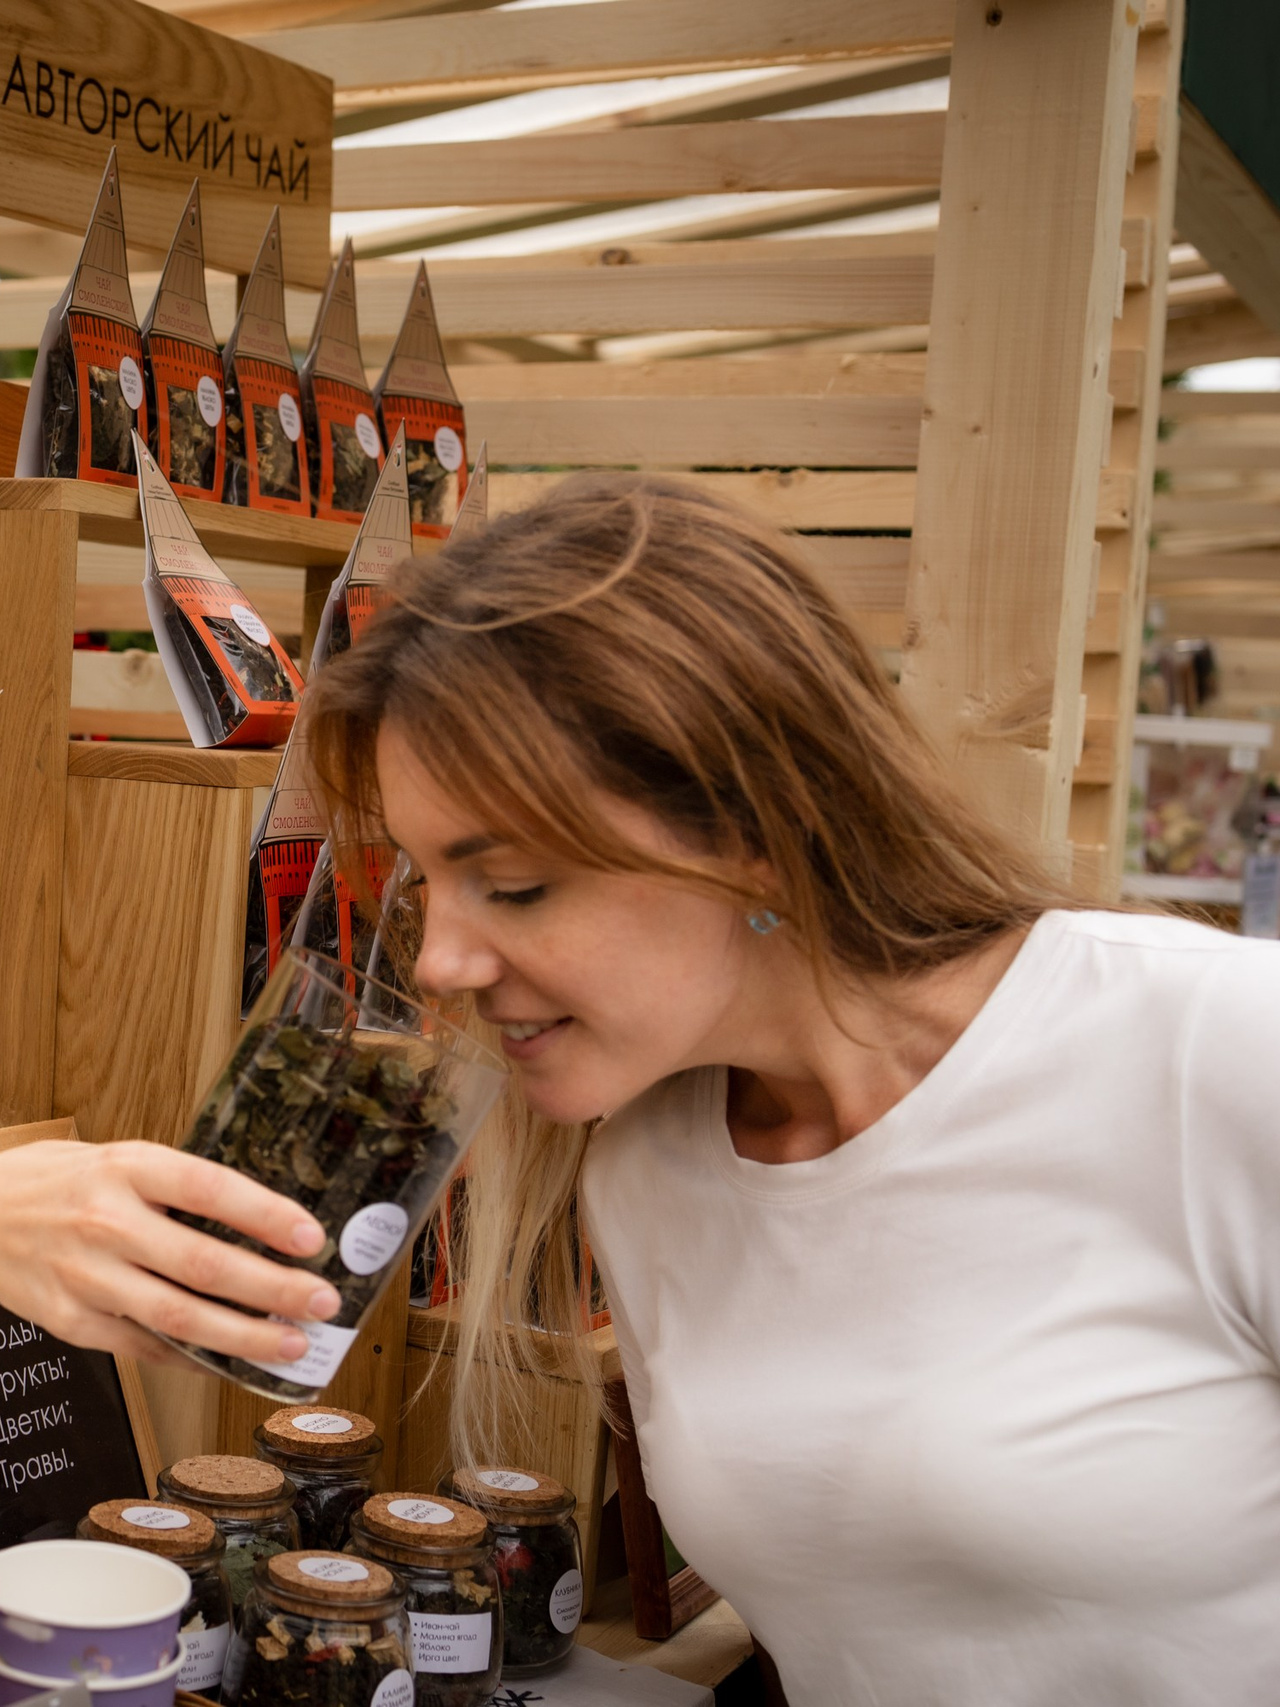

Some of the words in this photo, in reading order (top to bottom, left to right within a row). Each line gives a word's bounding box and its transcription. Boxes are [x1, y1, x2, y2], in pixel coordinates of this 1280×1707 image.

[1, 53, 234, 178] АВТОРСКИЙ
[244, 131, 310, 202] ЧАЙ
[294, 794, 312, 810] ЧАЙ
[420, 1620, 460, 1631] Иван-чай
[419, 1632, 455, 1641] Малина
[456, 1633, 478, 1642] ягода
[419, 1642, 451, 1651] Яблоко
[418, 1652, 440, 1662] Ирга
